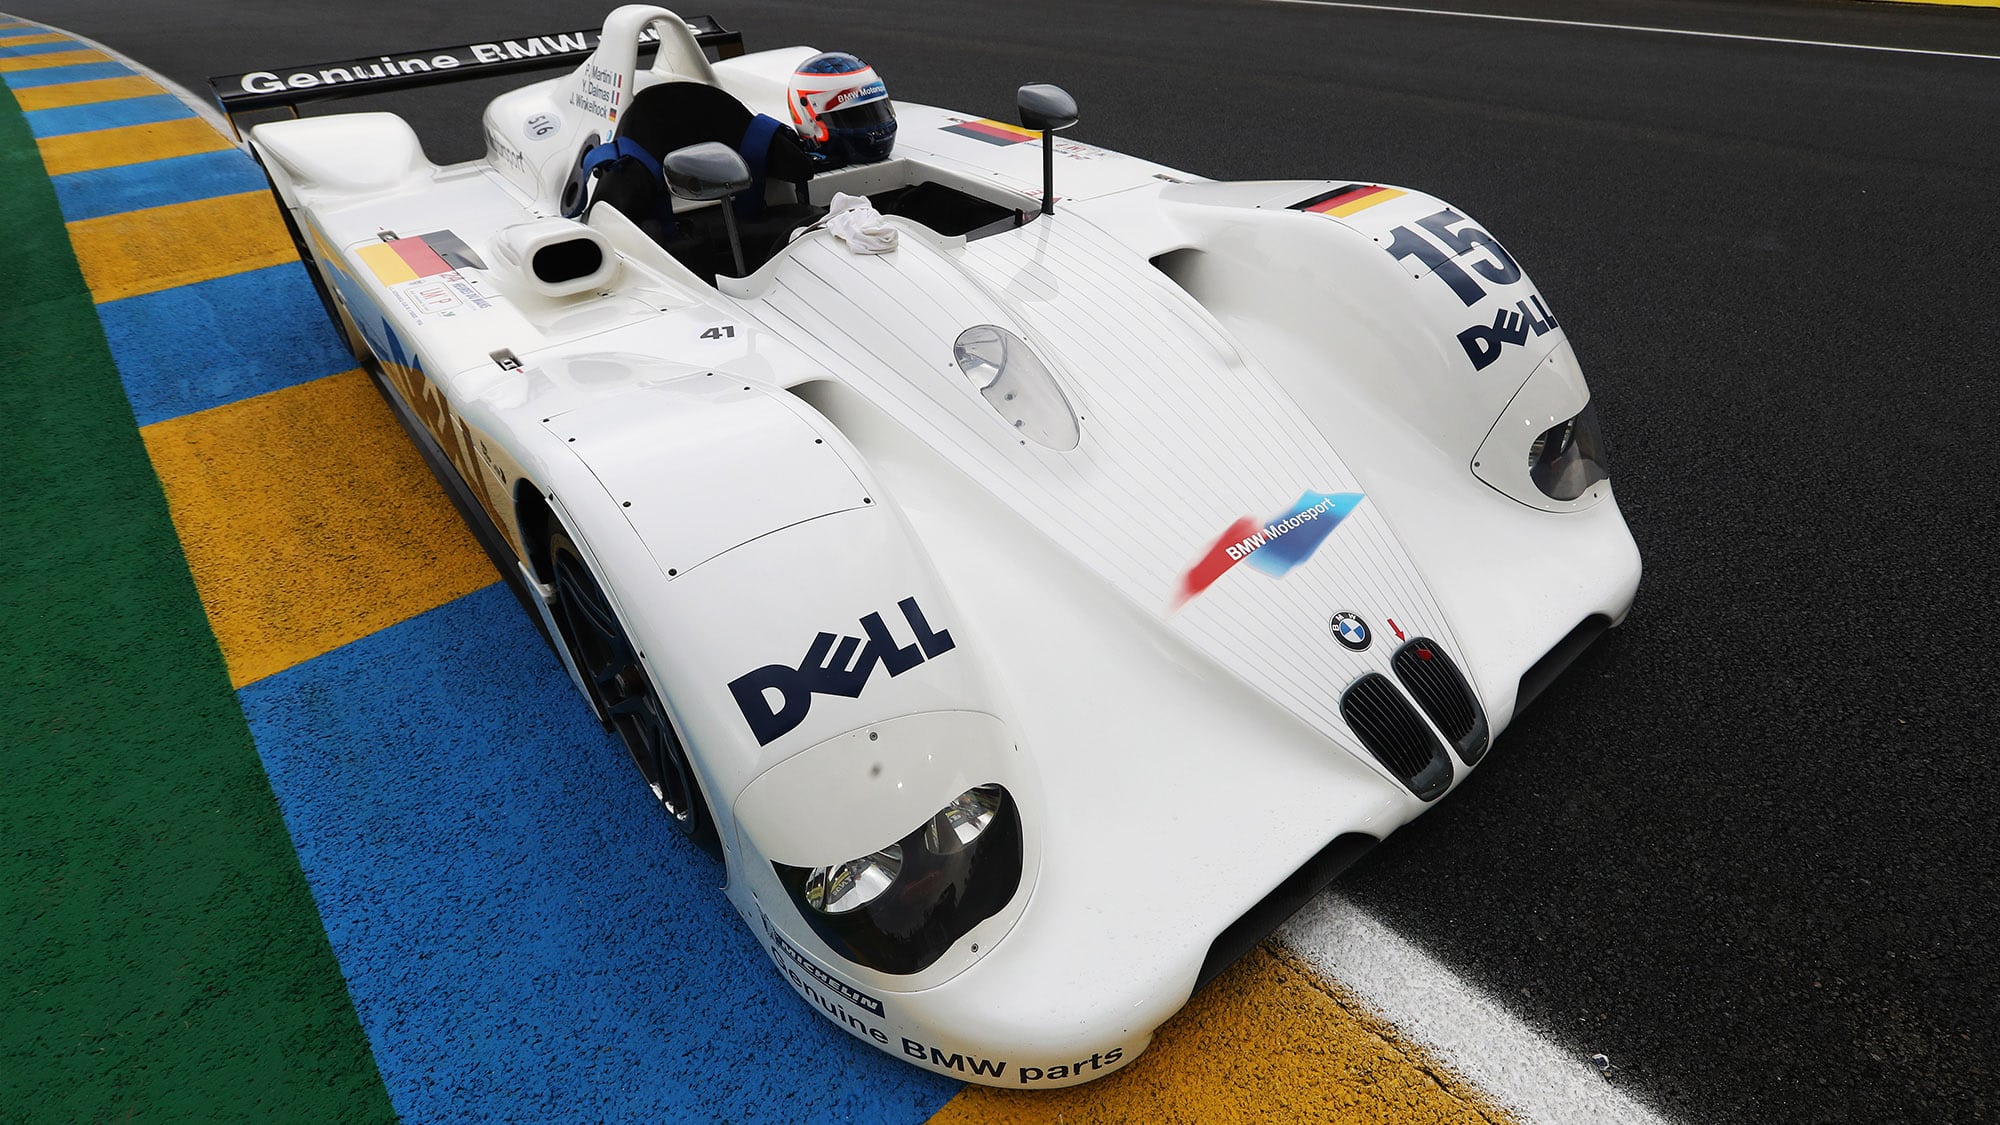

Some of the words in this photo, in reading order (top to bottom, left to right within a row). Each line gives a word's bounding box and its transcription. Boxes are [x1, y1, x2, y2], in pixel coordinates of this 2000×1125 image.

[241, 55, 460, 94] Genuine
[470, 31, 588, 64] BMW
[588, 82, 610, 102] Dalmas
[592, 66, 613, 85] Martini
[575, 93, 608, 119] Winkelhock
[837, 91, 859, 103] BMW
[1386, 209, 1521, 307] 15
[700, 325, 735, 340] 41
[1457, 295, 1558, 371] DELL
[1225, 532, 1266, 561] BMW
[1263, 497, 1336, 542] Motorsport
[1332, 613, 1356, 631] BMW
[727, 596, 956, 747] DELL
[780, 943, 878, 1010] MICHELIN
[771, 945, 889, 1045] Genuine
[901, 1037, 1007, 1078] BMW
[1019, 1046, 1124, 1084] parts
